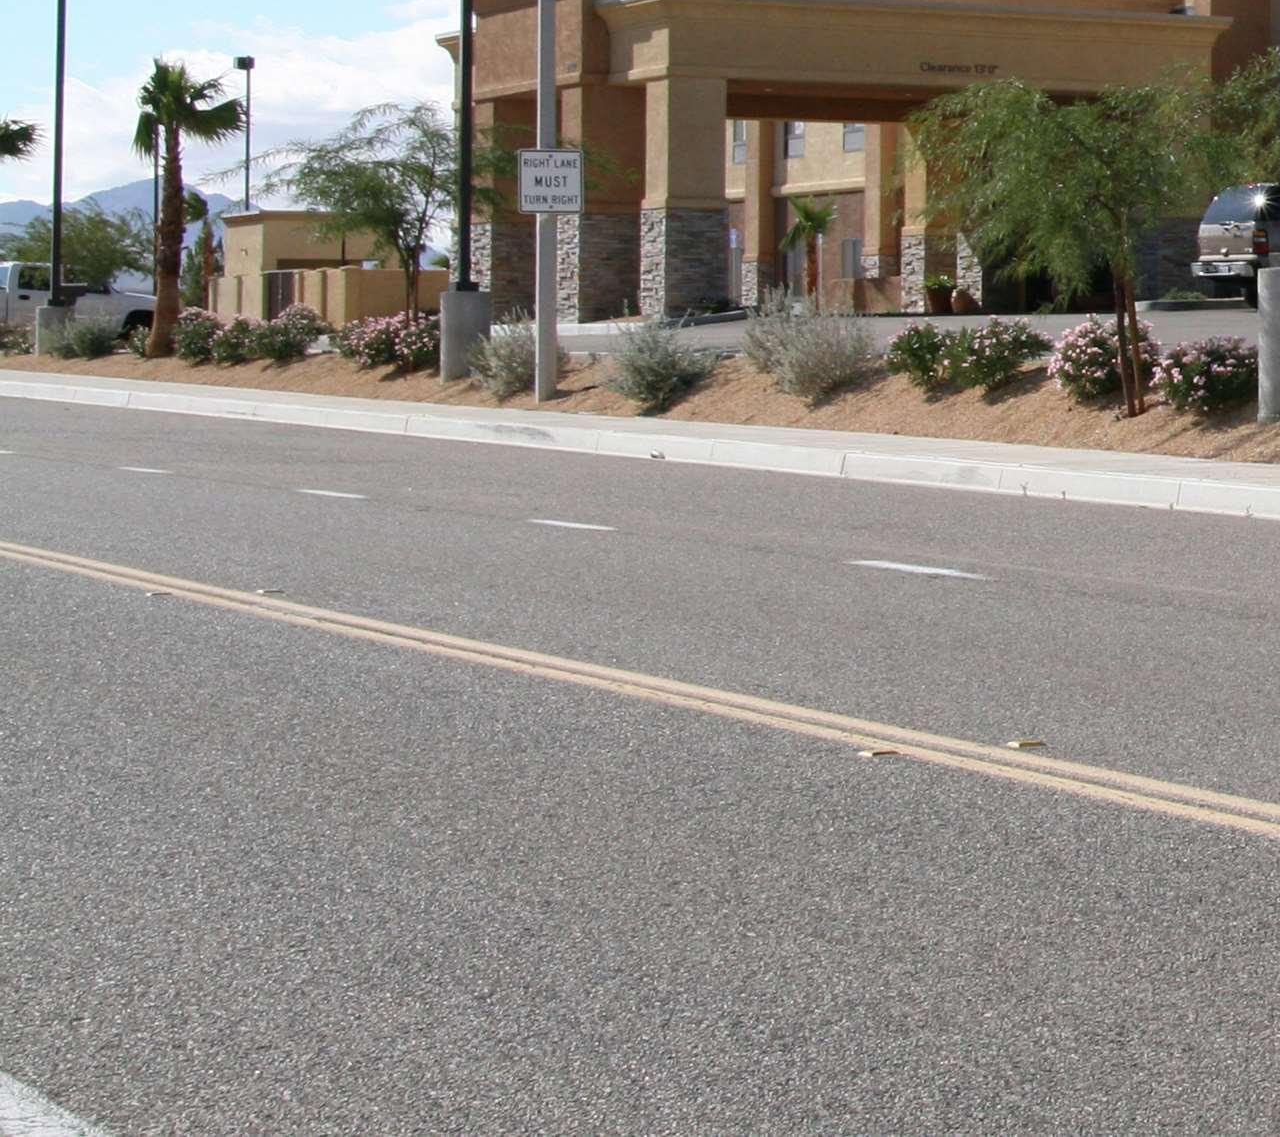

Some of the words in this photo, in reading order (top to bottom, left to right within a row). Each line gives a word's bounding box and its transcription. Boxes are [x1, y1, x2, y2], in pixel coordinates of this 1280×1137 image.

[523, 158, 550, 168] RIGHT
[554, 159, 578, 168] LANE
[534, 175, 568, 188] MUST
[523, 194, 548, 205] TURN
[551, 194, 579, 206] RIGHT
